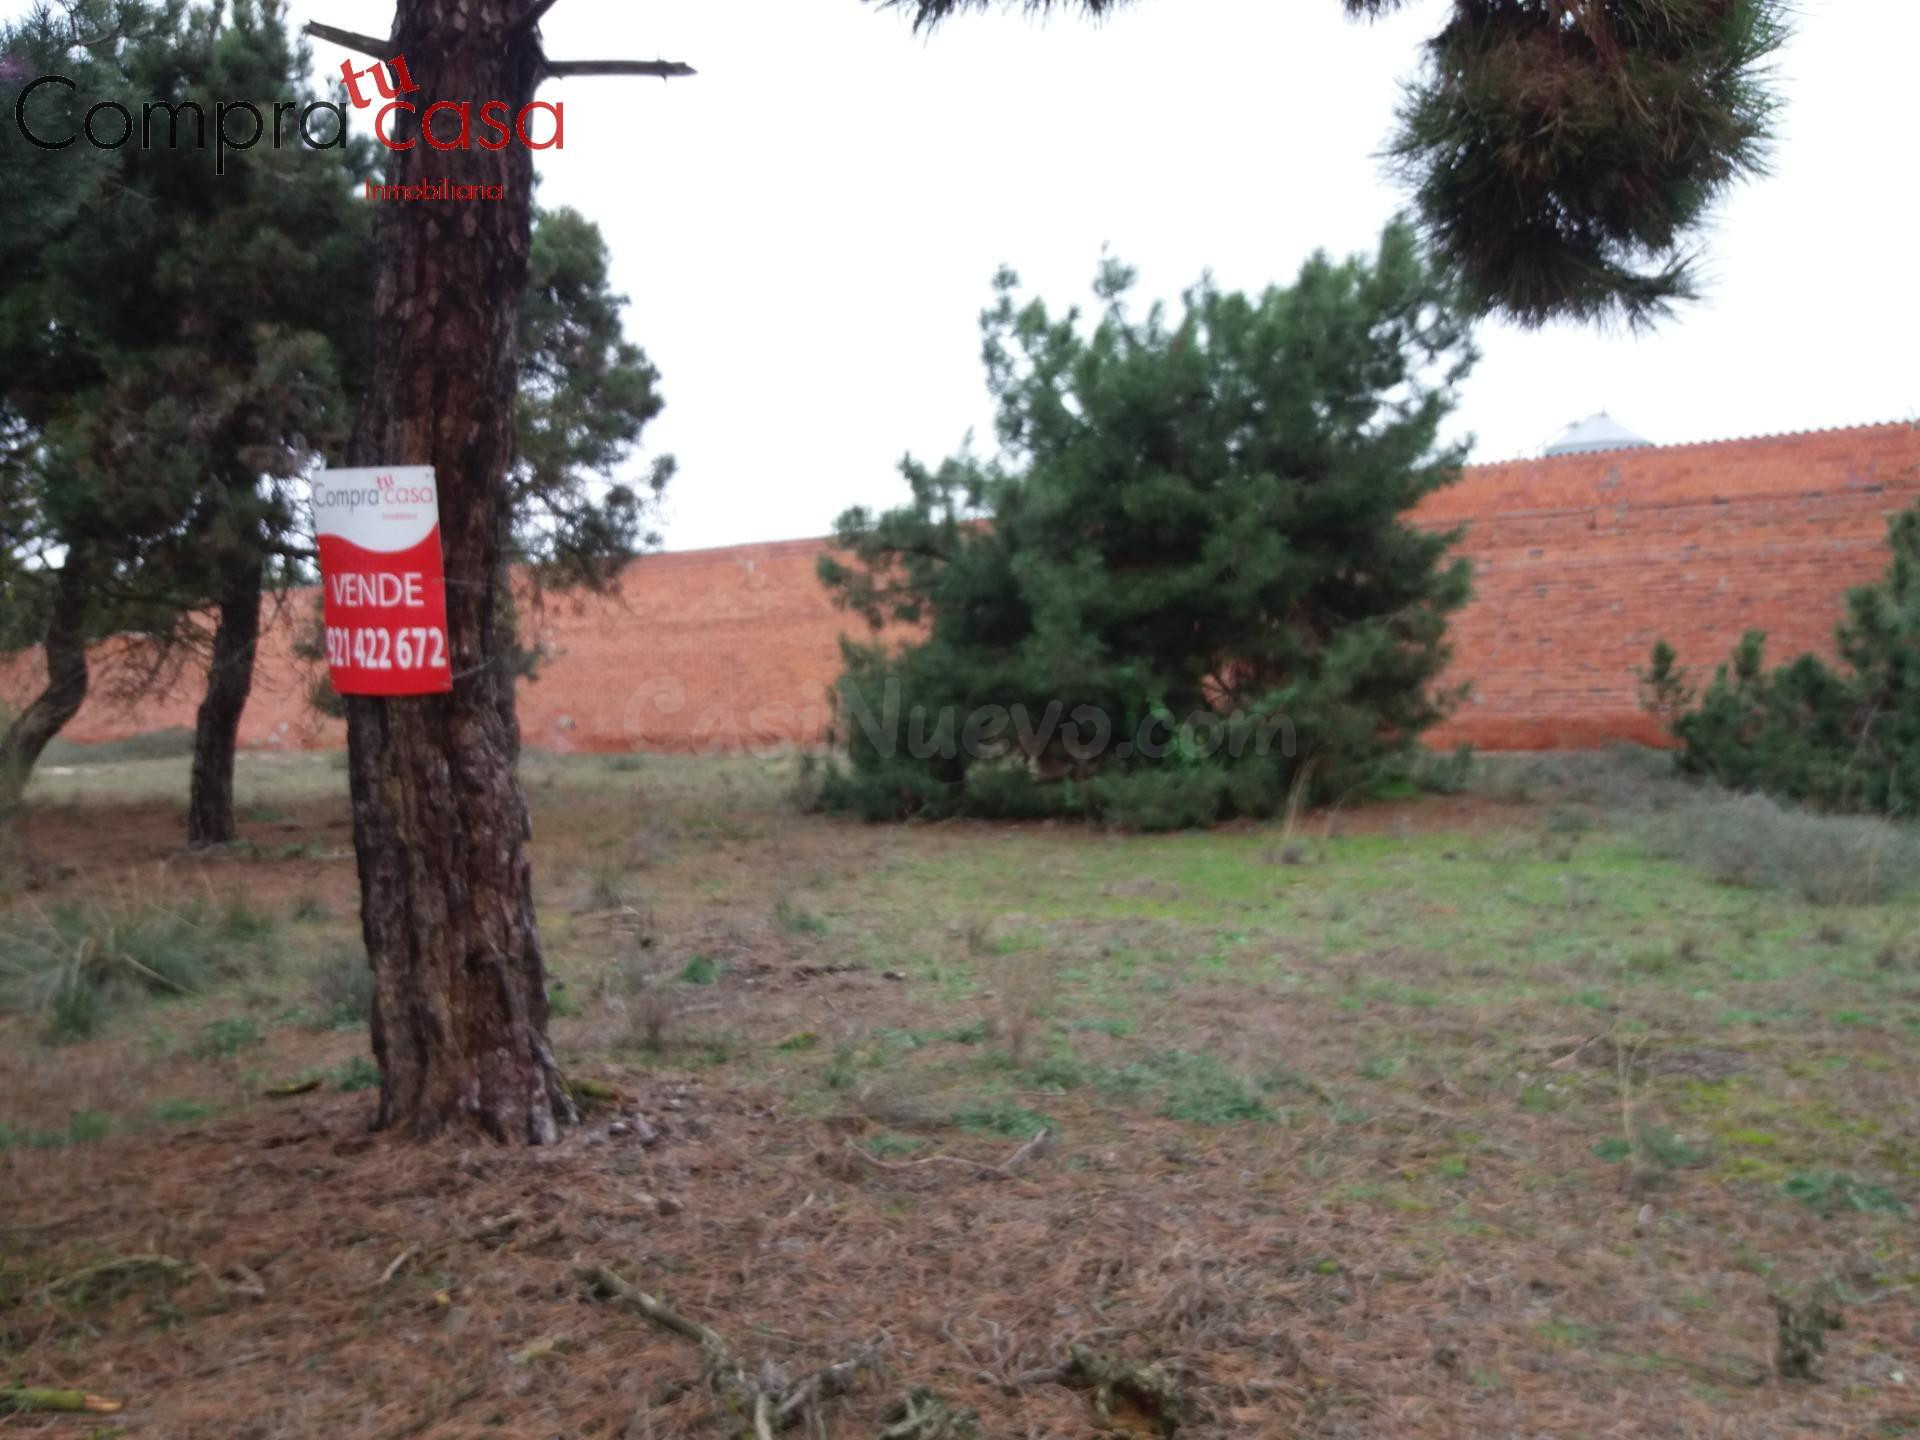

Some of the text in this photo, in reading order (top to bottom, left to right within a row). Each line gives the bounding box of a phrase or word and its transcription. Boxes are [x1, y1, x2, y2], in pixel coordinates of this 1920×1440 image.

[313, 482, 433, 514] Compra casa
[331, 572, 425, 608] VENDE
[354, 626, 393, 669] 422
[396, 626, 447, 669] 672
